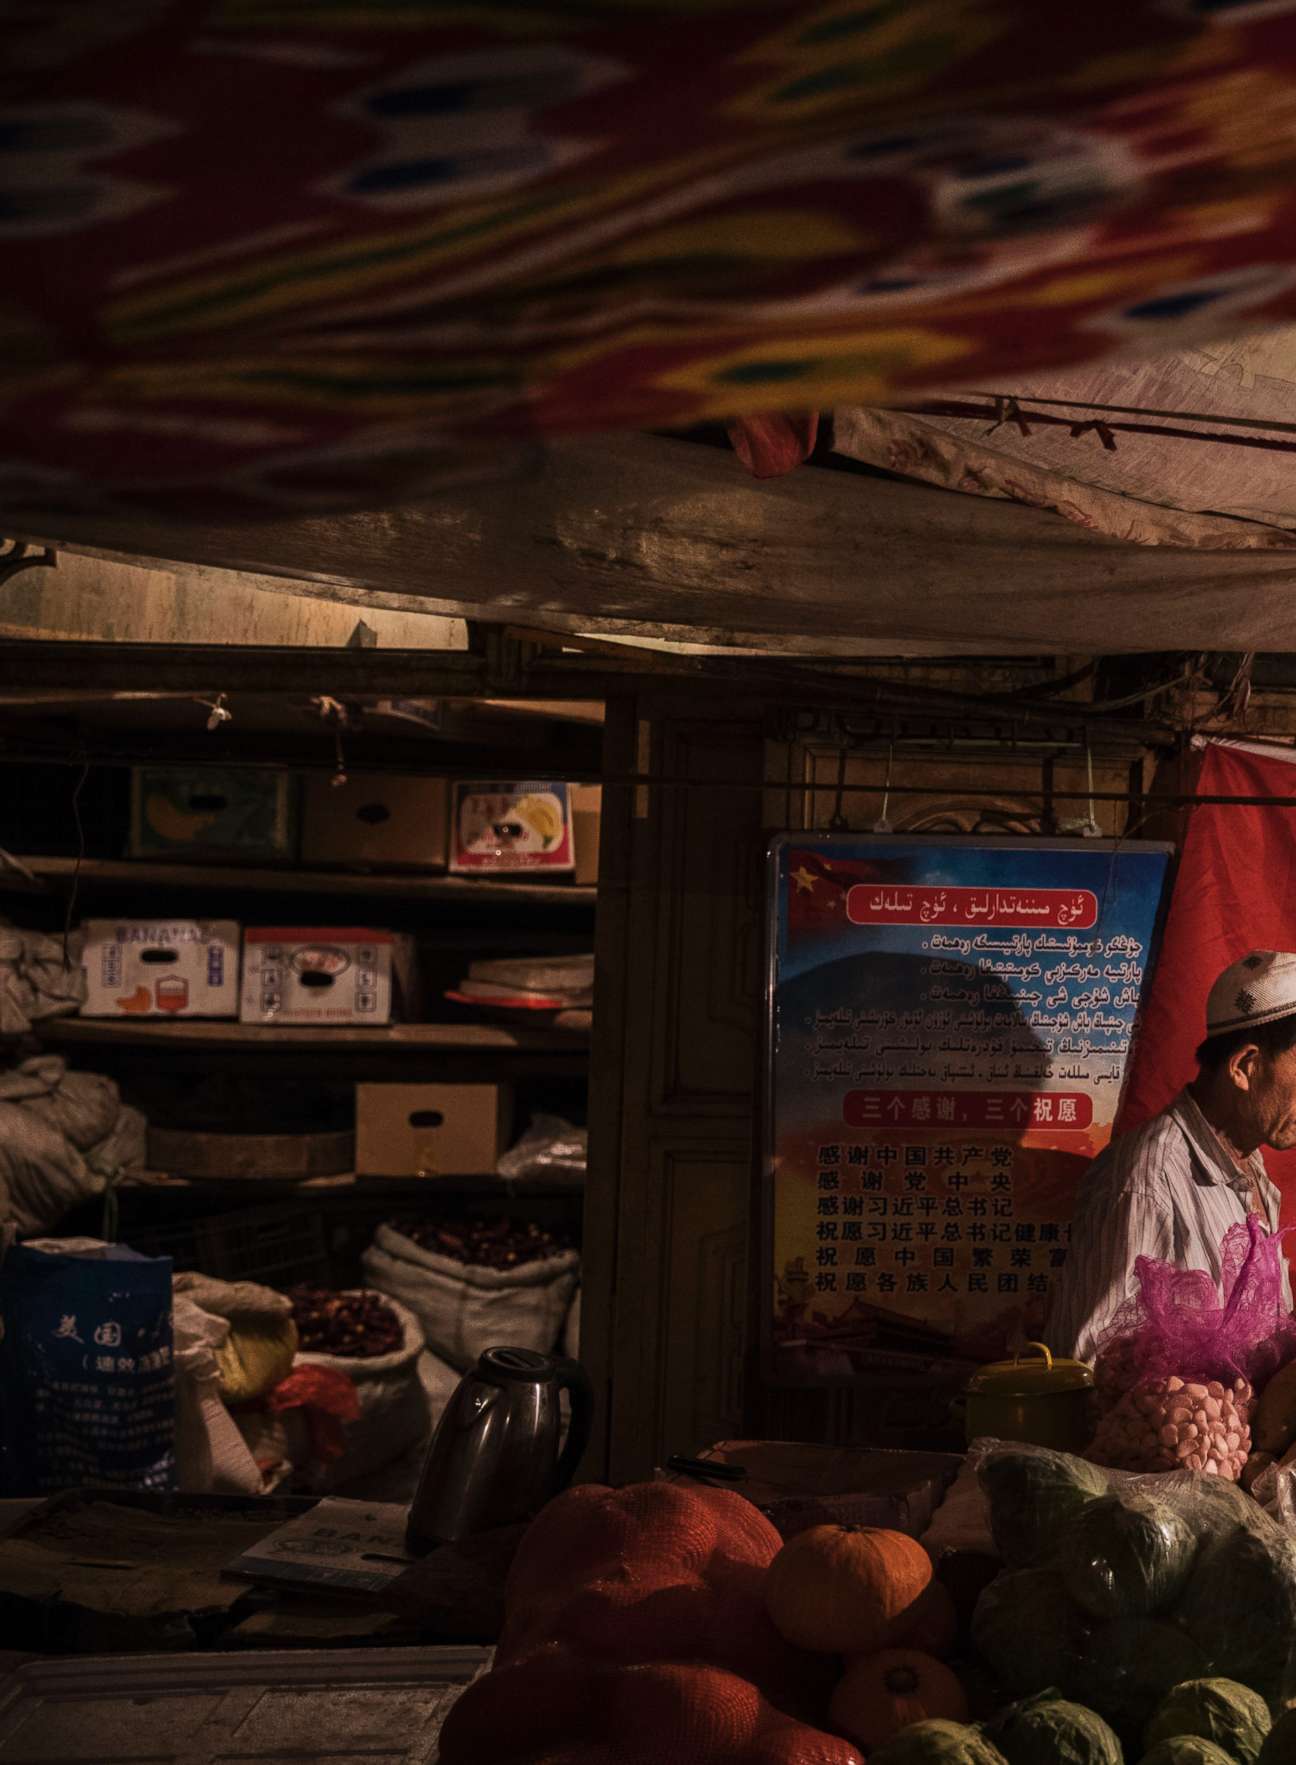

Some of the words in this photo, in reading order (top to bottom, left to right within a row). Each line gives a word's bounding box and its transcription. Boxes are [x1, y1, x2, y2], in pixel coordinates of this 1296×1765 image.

[818, 1146, 1013, 1167] 感谢中国共产党
[817, 1171, 1012, 1192] 感谢党中央
[816, 1197, 1014, 1217] 感谢习近平总书记
